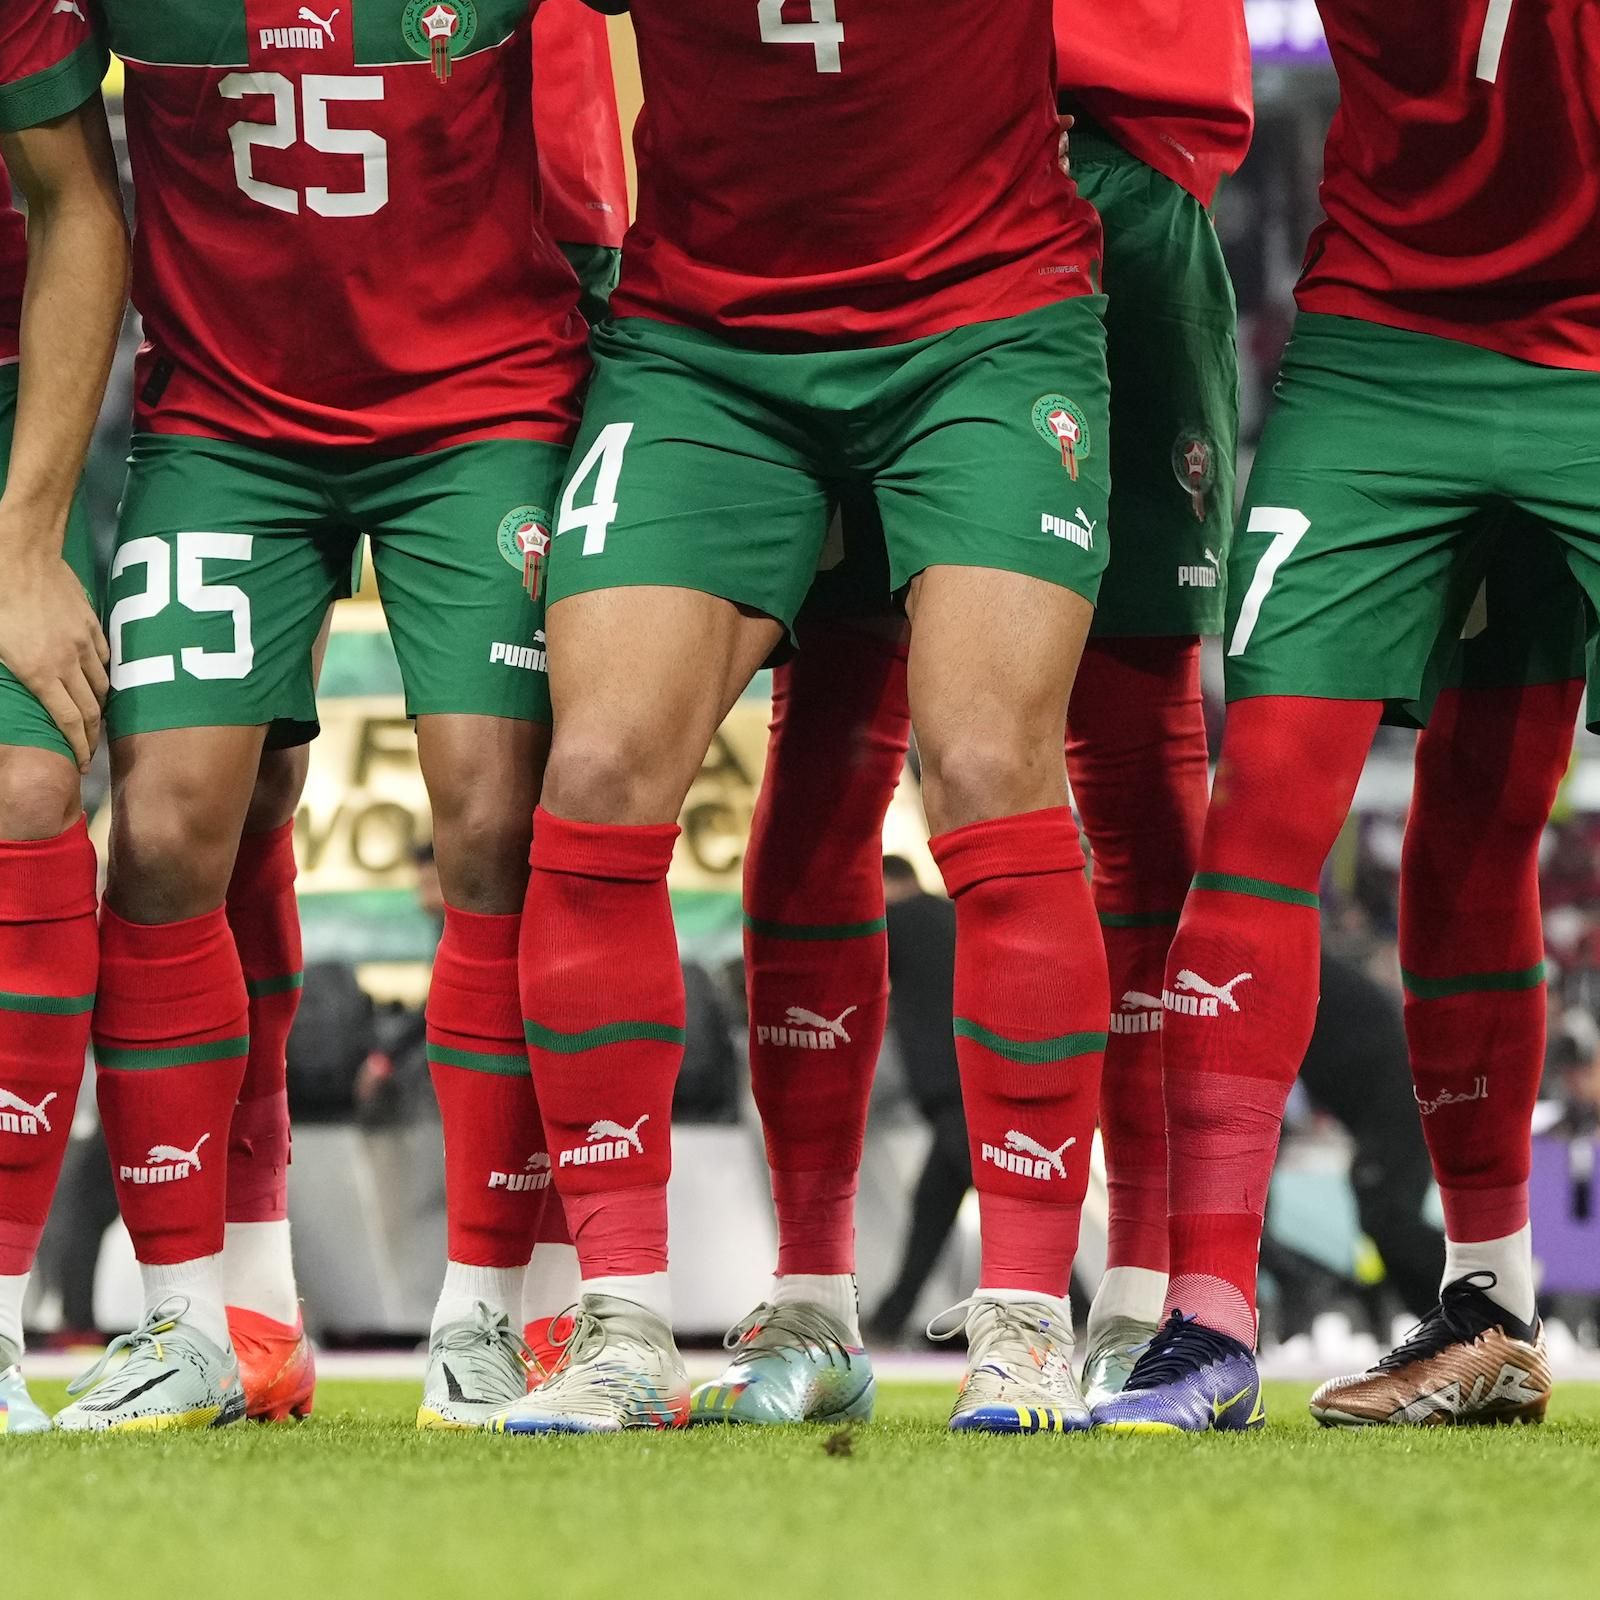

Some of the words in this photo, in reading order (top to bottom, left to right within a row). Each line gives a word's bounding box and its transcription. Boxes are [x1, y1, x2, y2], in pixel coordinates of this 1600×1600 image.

[259, 27, 324, 50] PUMA
[219, 72, 389, 218] 25
[556, 422, 635, 556] 4
[1041, 513, 1090, 551] PUMA
[1178, 564, 1218, 587] PUMA
[1228, 506, 1311, 657] 7
[109, 532, 254, 691] 25
[757, 1024, 836, 1049] PUMA
[120, 1161, 189, 1184] PUMA
[559, 1140, 631, 1167] PUMA
[982, 1142, 1052, 1180] PUMA
